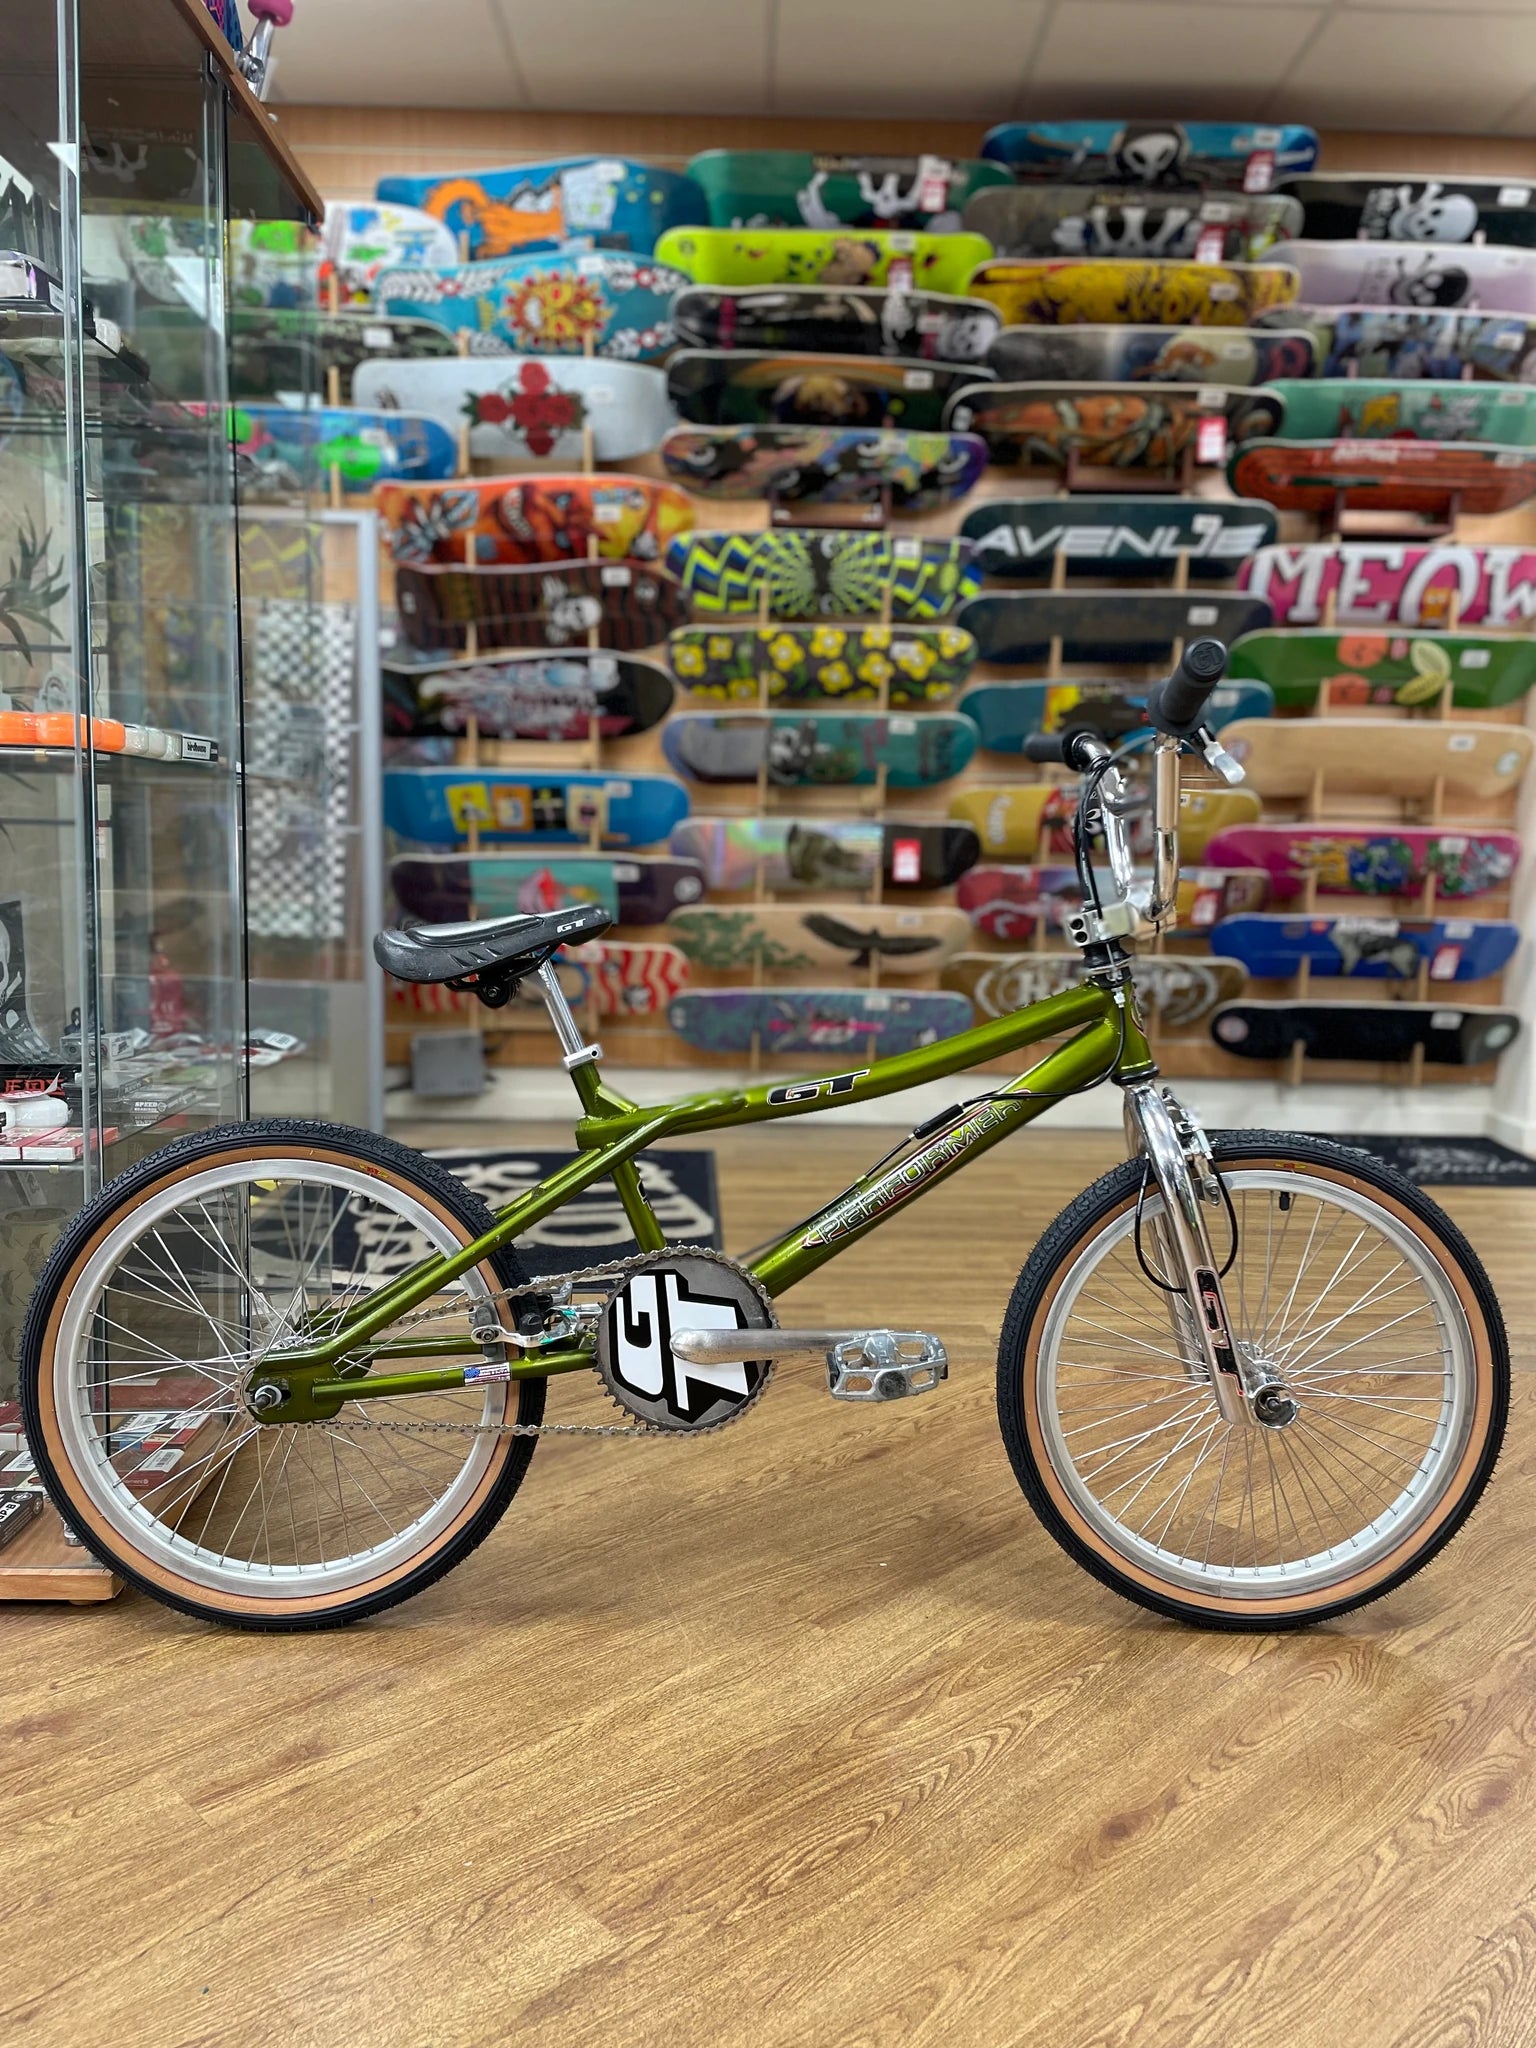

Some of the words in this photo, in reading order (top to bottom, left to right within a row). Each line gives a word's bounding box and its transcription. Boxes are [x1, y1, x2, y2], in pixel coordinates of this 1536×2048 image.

[972, 524, 1267, 558] AVENUE
[556, 917, 587, 934] GT
[767, 1068, 871, 1106] GT
[815, 1093, 1027, 1245] PERFORMER
[612, 1271, 753, 1416] GT
